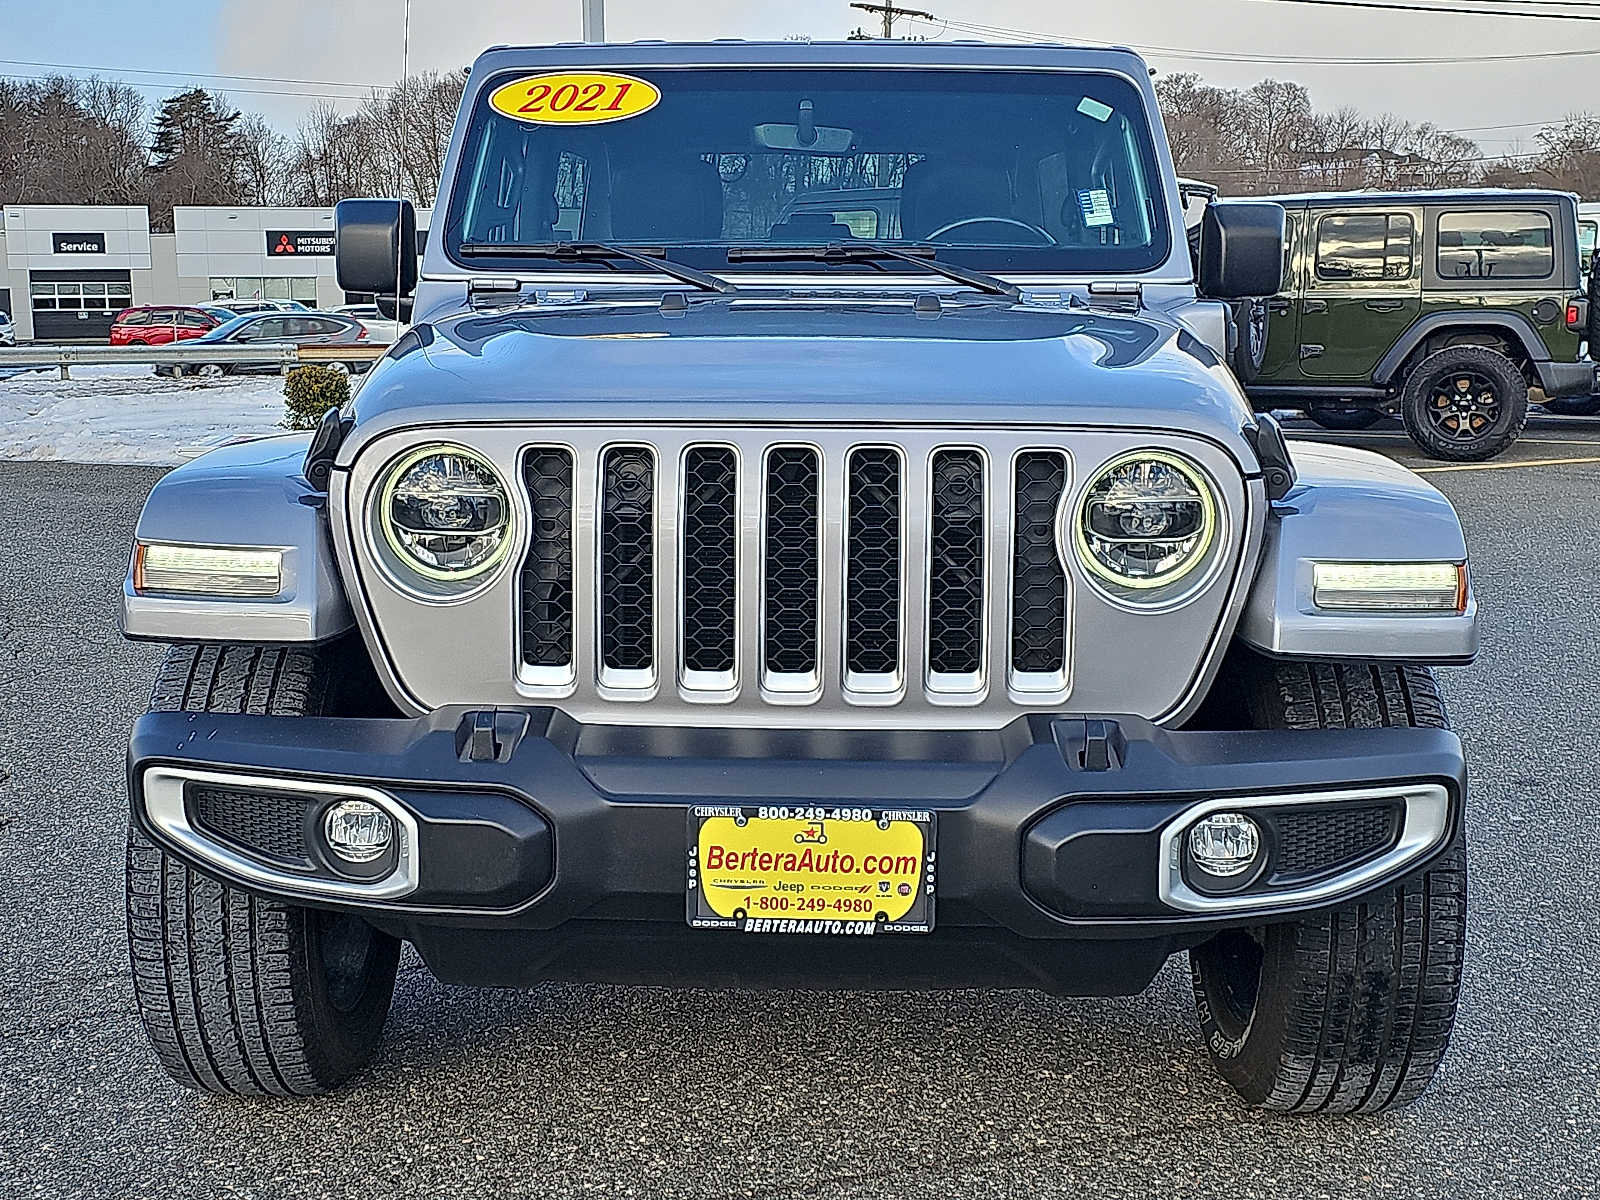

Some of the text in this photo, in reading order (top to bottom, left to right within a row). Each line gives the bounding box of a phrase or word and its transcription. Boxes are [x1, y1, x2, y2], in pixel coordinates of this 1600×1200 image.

[517, 83, 632, 113] 2021
[60, 242, 98, 251] Service
[297, 245, 331, 253] MOTORS
[694, 806, 742, 817] CHRYSLER
[758, 806, 873, 821] 800-249-4980
[881, 810, 931, 822] CHRYSLER
[706, 845, 918, 874] BerteraAuto.com
[688, 846, 697, 889] Jeep
[926, 851, 935, 895] Jeep
[773, 880, 805, 893] Jeep
[743, 896, 873, 913] 1-800-249-4980
[692, 919, 737, 928] DODGE
[744, 918, 877, 936] BERTERAAUTO.COM
[883, 924, 929, 933] DODGE
